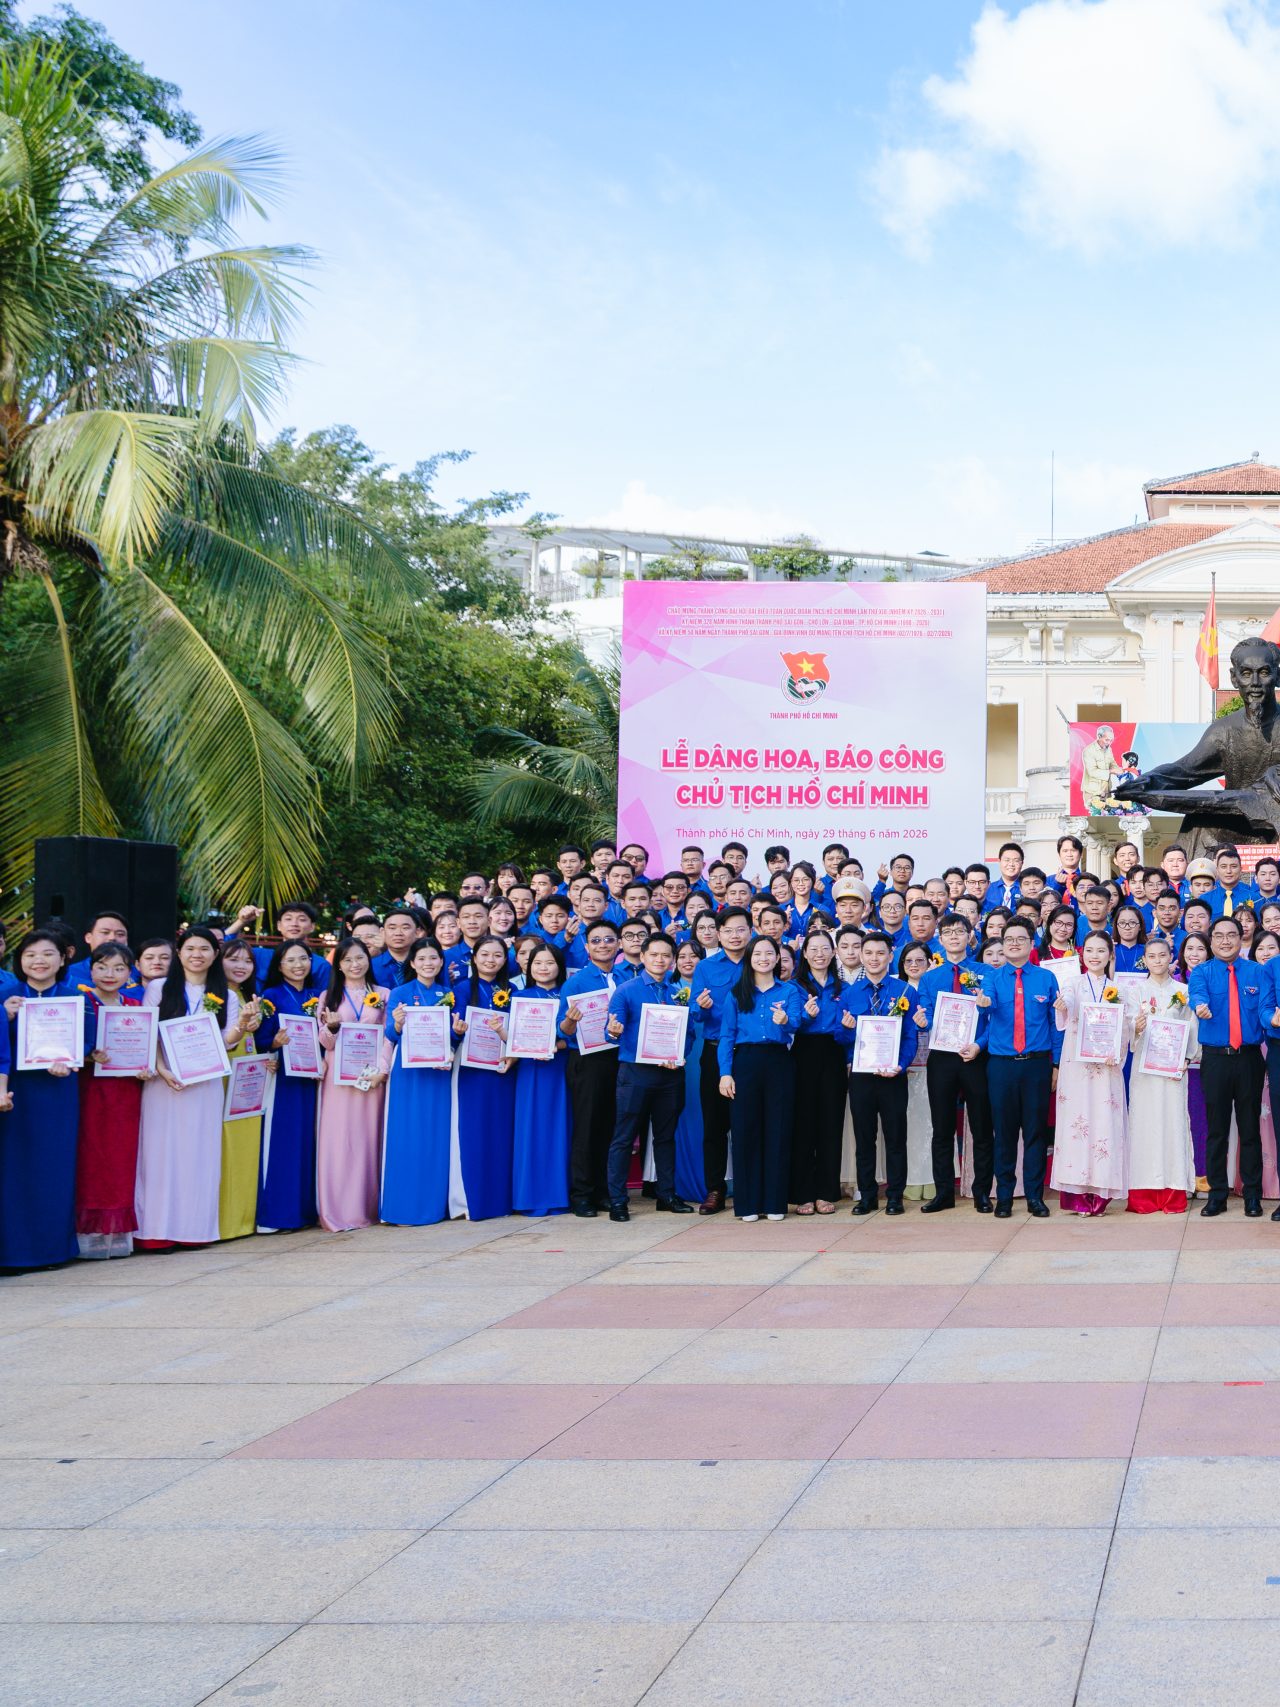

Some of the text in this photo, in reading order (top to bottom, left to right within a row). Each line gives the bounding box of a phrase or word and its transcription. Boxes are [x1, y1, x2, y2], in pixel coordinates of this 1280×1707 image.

[662, 738, 944, 773] LỄ DÂNG HOA, BÁO CÔNG
[677, 776, 928, 810] CHỦ TỊCH HỒ CHÍ MINH
[676, 827, 928, 840] Thành phố Hồ Chí Minh, ngày 29 tháng 6 năm 2026
